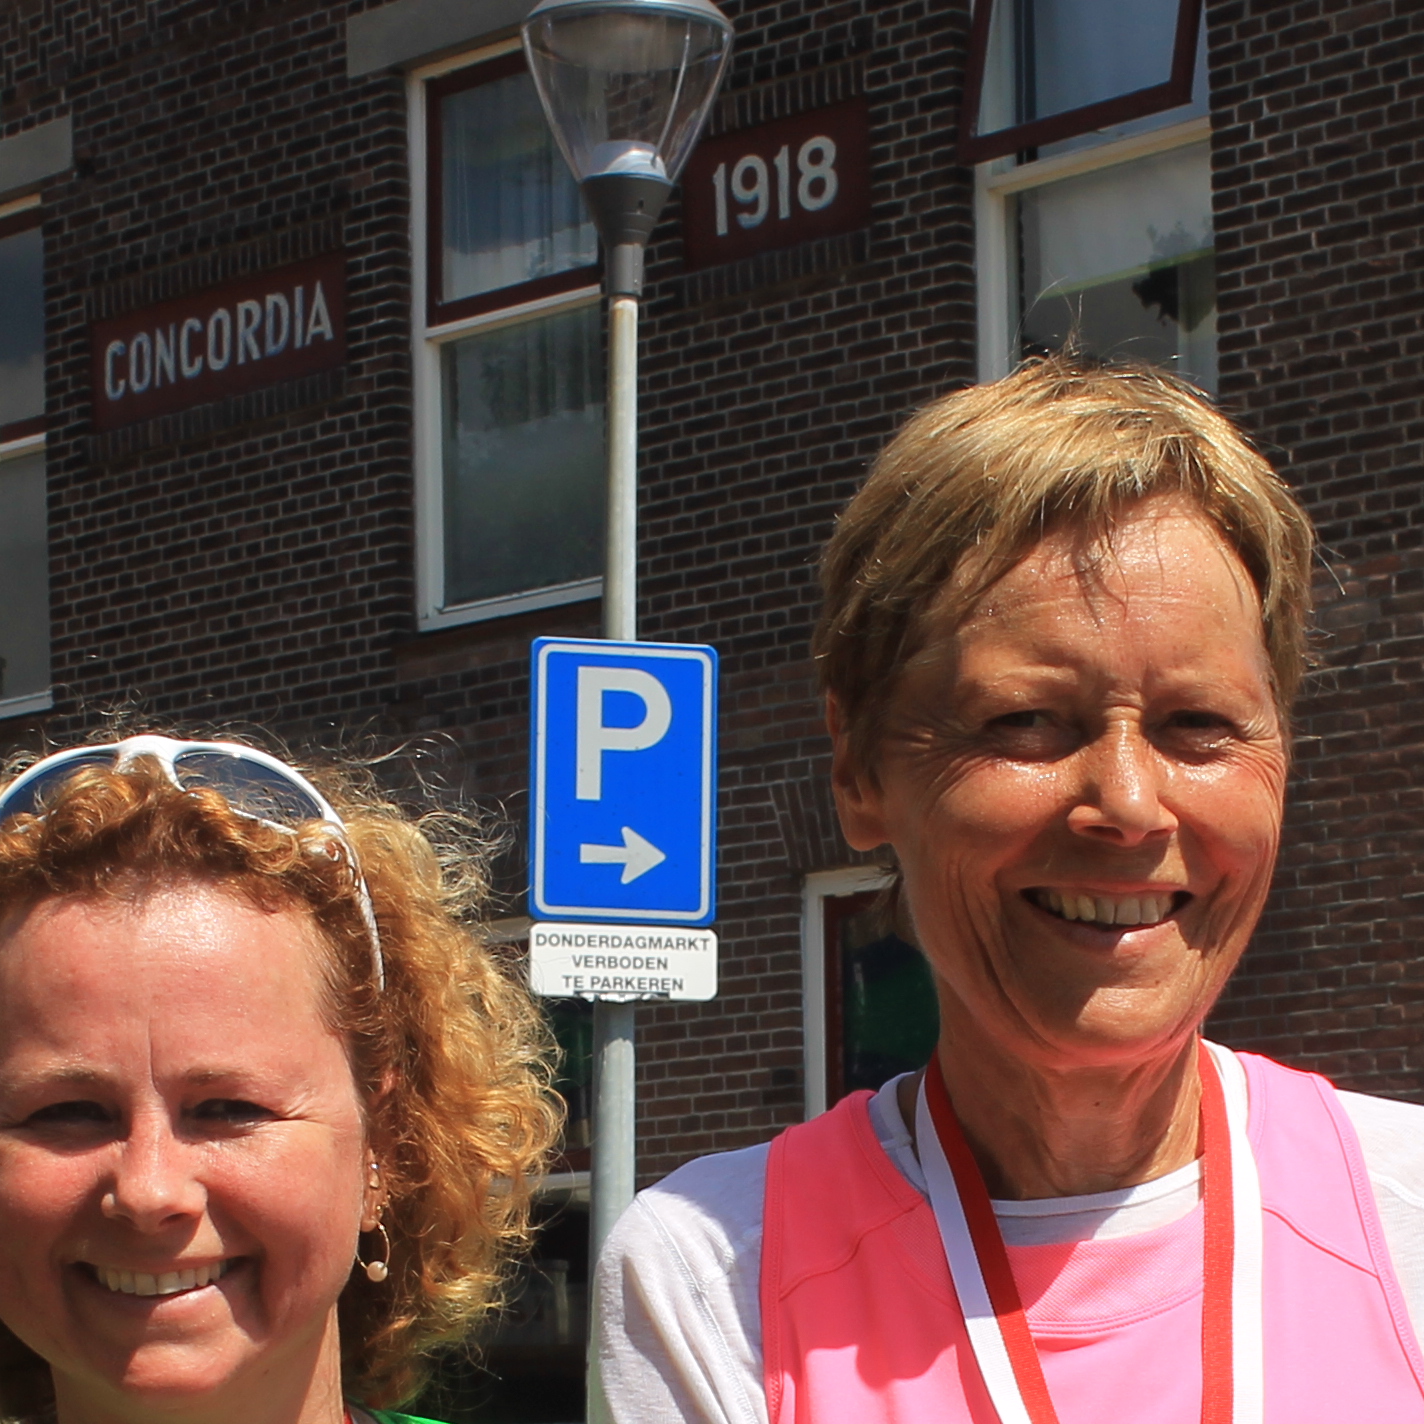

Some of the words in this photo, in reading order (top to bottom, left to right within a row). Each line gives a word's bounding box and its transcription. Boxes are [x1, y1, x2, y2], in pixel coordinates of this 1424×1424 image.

[712, 135, 839, 237] 1918
[104, 280, 334, 400] CONCORDIA
[576, 666, 672, 801] P
[535, 933, 711, 951] DONDERDAGMARKT
[572, 955, 669, 971] VERBODEN
[562, 975, 584, 989] TE
[590, 976, 684, 991] PARKEREN
